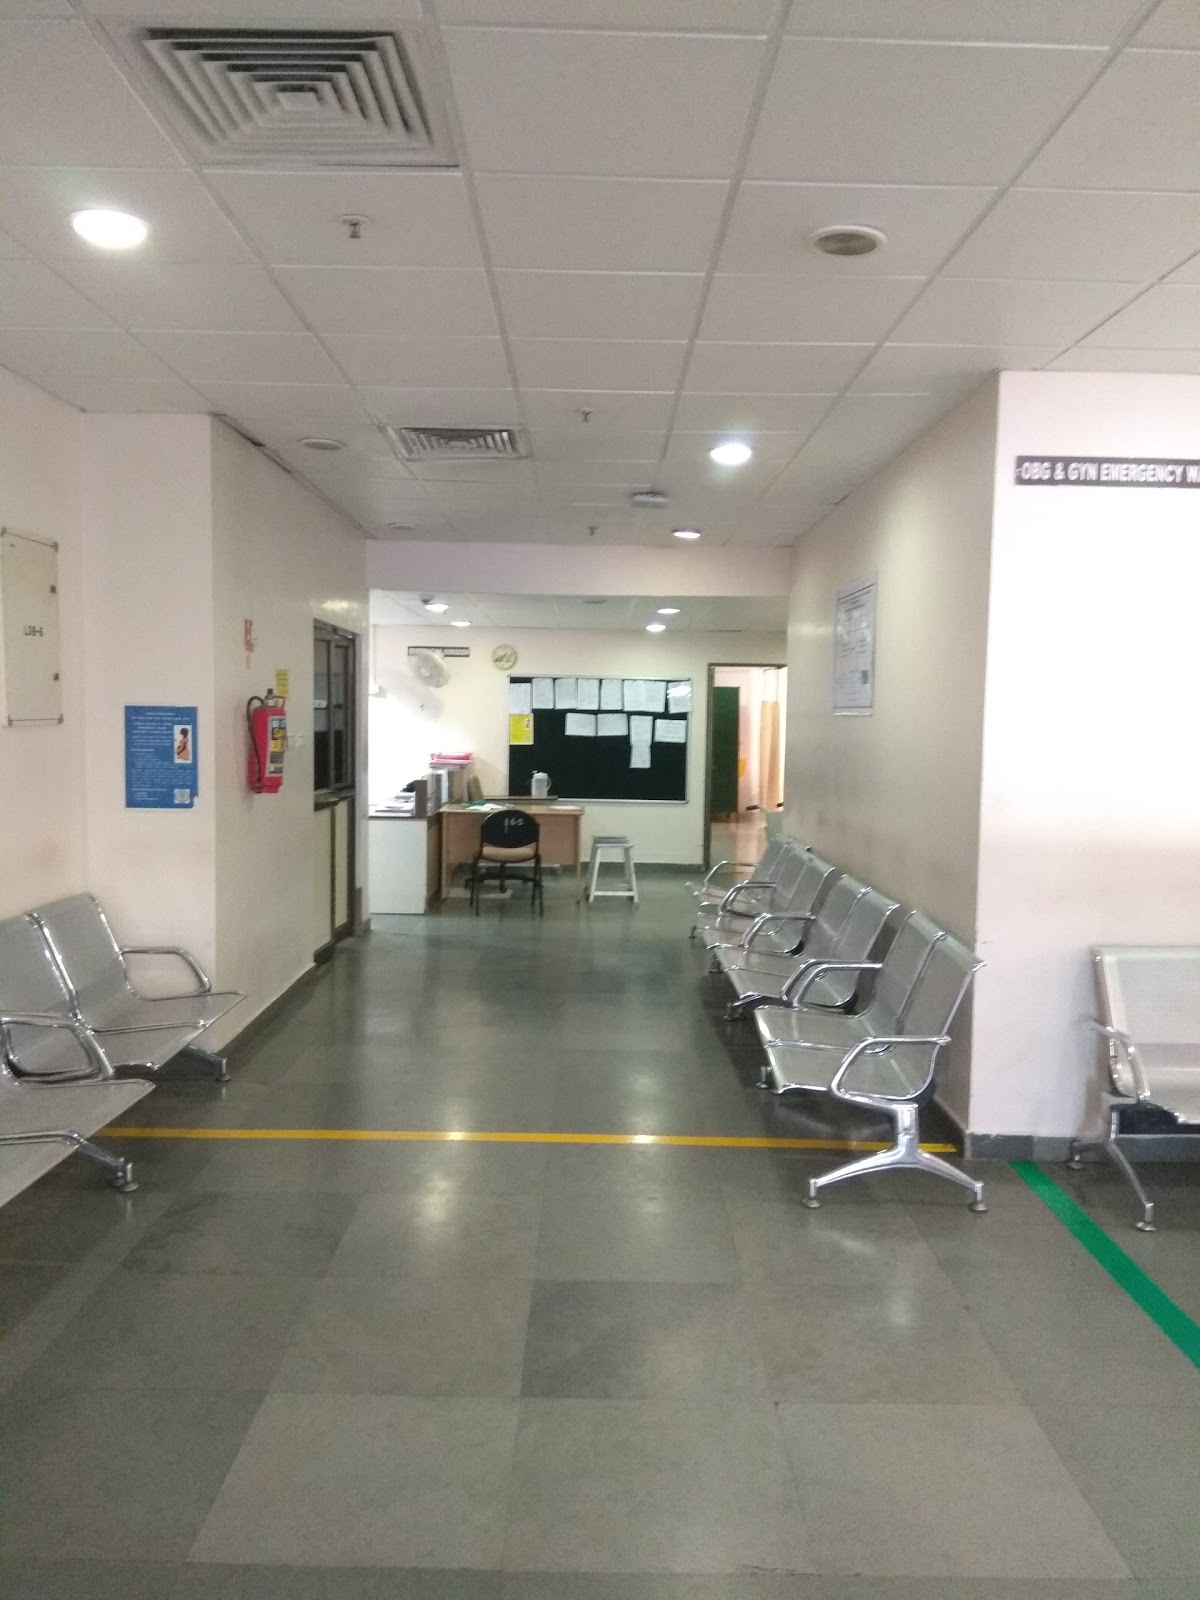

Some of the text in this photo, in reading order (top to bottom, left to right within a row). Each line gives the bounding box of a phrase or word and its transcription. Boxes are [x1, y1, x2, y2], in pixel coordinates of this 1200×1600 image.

[1021, 461, 1052, 481] OBG
[1053, 461, 1066, 481] &
[1067, 462, 1099, 481] GYN
[1100, 463, 1185, 483] EMERGENCY
